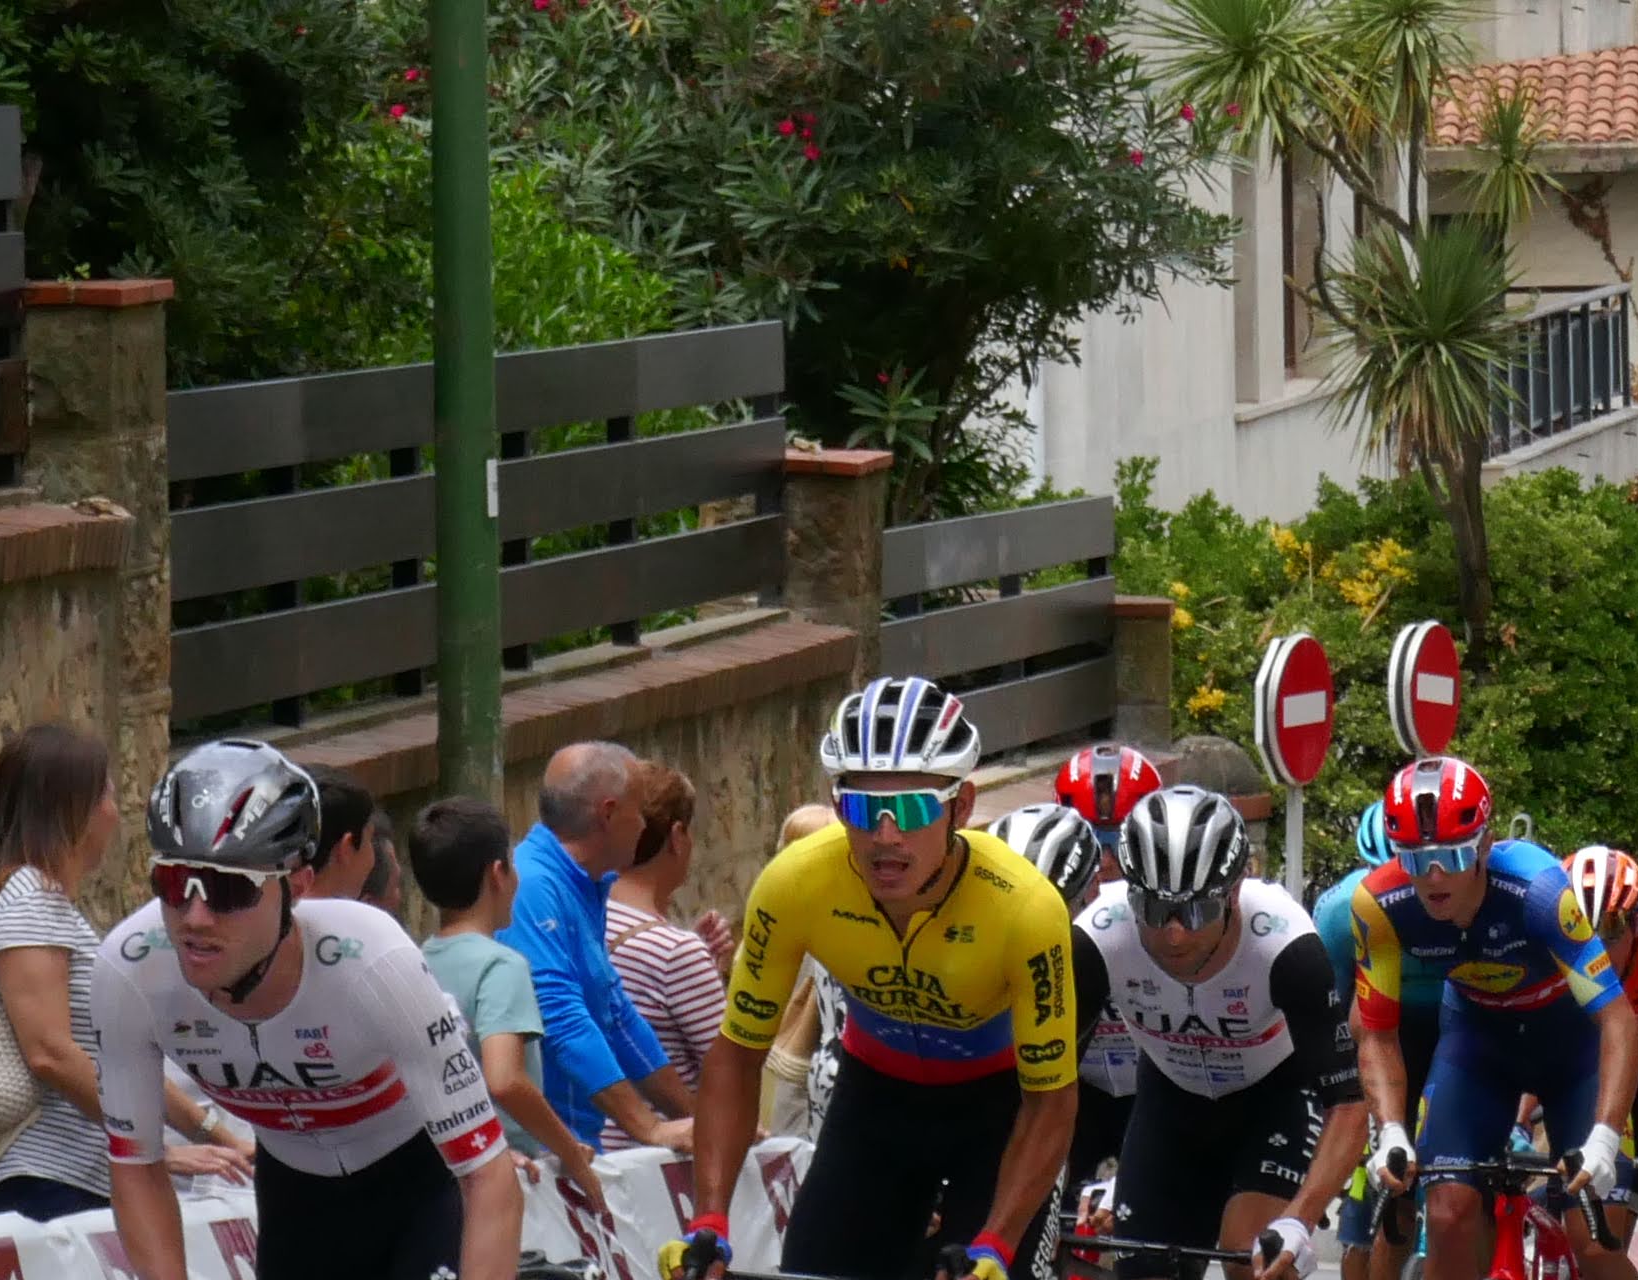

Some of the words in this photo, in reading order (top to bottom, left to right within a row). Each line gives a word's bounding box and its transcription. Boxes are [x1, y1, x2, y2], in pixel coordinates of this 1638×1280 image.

[1058, 842, 1082, 888] MET
[1489, 877, 1527, 898] TREK
[746, 907, 778, 981] ALEA
[1027, 952, 1053, 1027] RGA
[1135, 1012, 1251, 1038] UAE
[187, 1062, 343, 1088] UAE
